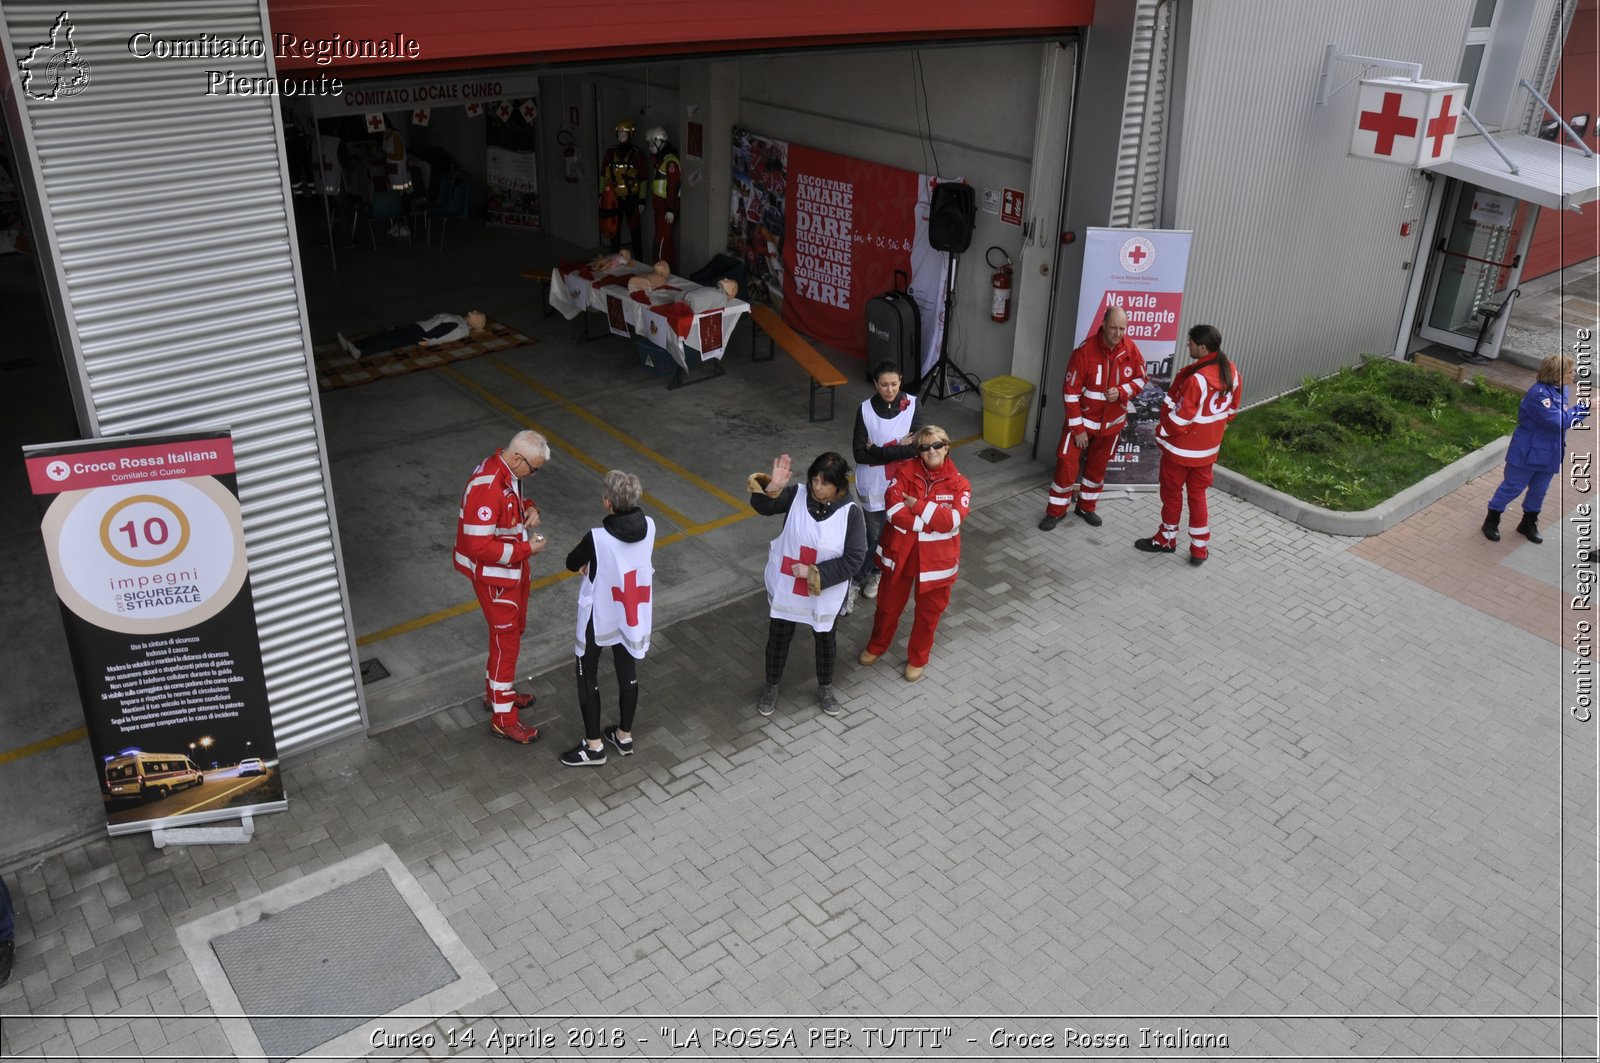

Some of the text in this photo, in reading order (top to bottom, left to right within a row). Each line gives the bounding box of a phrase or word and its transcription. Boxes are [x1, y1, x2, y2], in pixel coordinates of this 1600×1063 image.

[345, 82, 502, 106] COMITATO LOCALE CUNEO
[797, 173, 853, 193] ASCOLTARE
[796, 183, 852, 209] AMARE
[796, 199, 852, 221] CREDERE
[796, 210, 852, 241] DARE
[796, 230, 851, 252] RICEVERE
[796, 241, 851, 266] GIOCARE
[796, 253, 851, 279] VOLARE
[794, 266, 850, 290] SORRIDERE
[794, 276, 850, 310] FARE
[1105, 292, 1157, 308] Ne vale
[74, 451, 217, 474] Croce Rossa Italiana
[111, 467, 186, 482] Comitato di Cuneo
[119, 517, 168, 548] 10
[110, 568, 198, 590] impegni
[123, 585, 200, 602] SICUREZZA
[126, 593, 202, 611] STRADALE
[146, 649, 167, 657] Indossa
[107, 664, 126, 672] Modera
[132, 660, 150, 668] velocità
[155, 656, 176, 664] mantieni
[117, 671, 142, 679] assumere
[143, 668, 158, 676] alcool
[195, 662, 209, 670] prima
[143, 676, 165, 684] telefono
[190, 670, 211, 678] durante
[218, 668, 232, 676] guida
[108, 691, 124, 699] visibile
[185, 680, 203, 688] pedone
[120, 698, 139, 706] Impara
[145, 694, 166, 702] rispetta
[122, 705, 145, 714] Mantieni
[161, 700, 180, 708] veicolo
[111, 717, 125, 725] Segui
